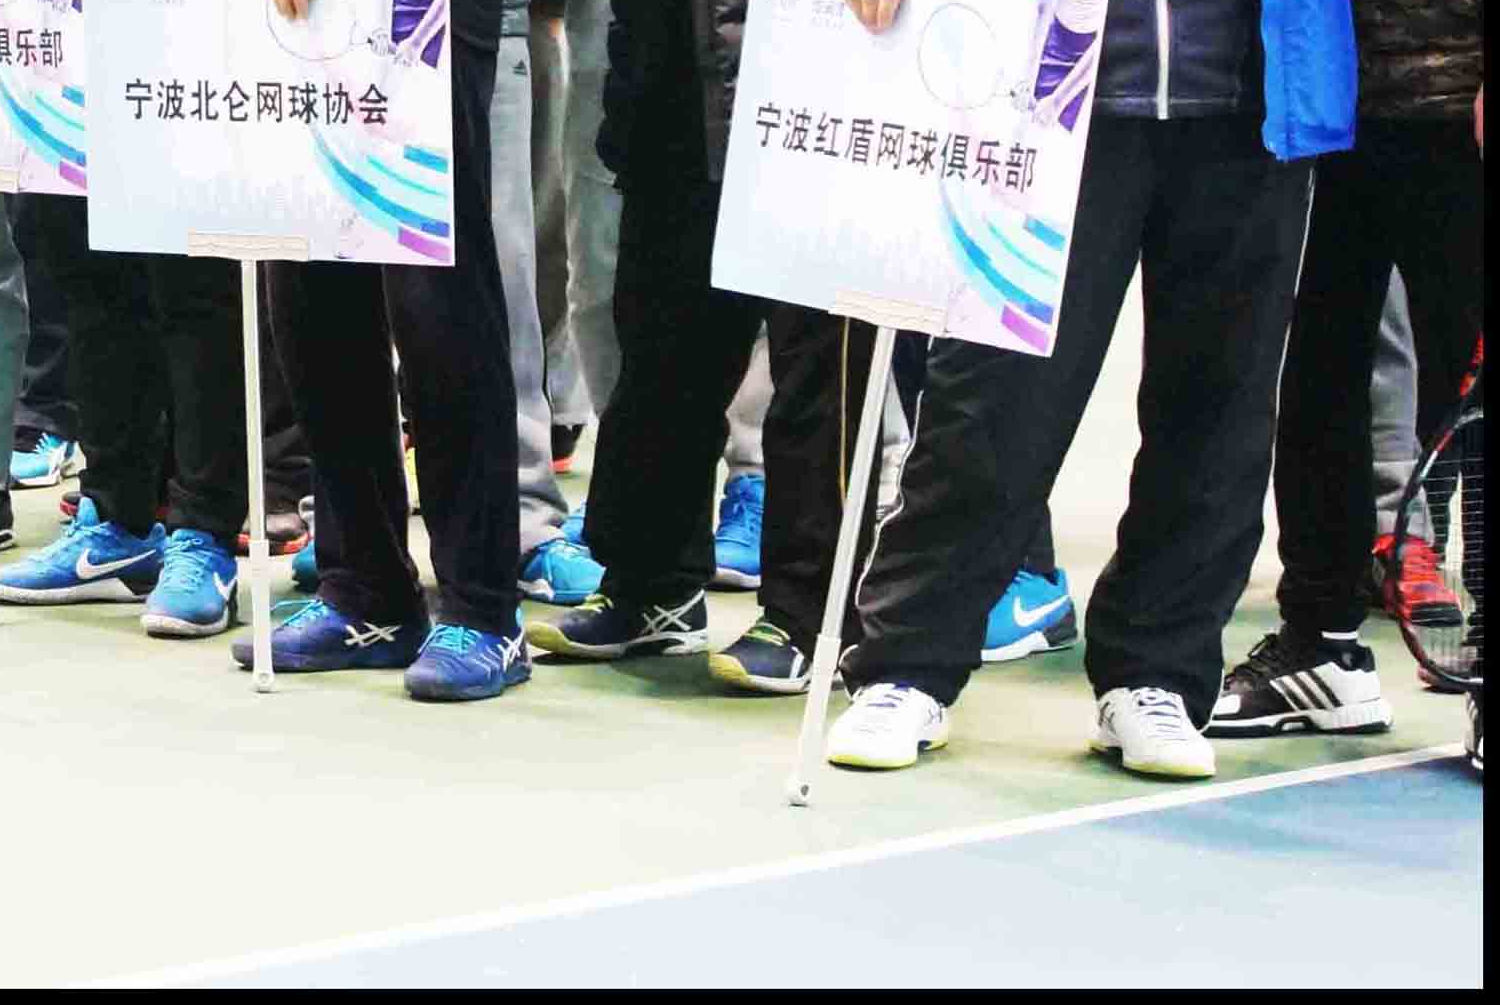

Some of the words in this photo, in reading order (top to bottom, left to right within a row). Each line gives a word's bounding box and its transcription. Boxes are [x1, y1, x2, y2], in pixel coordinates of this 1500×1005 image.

[125, 77, 389, 126] 宁波北仑网球协会
[755, 101, 1038, 194] 宁波红盾网球俱乐部
